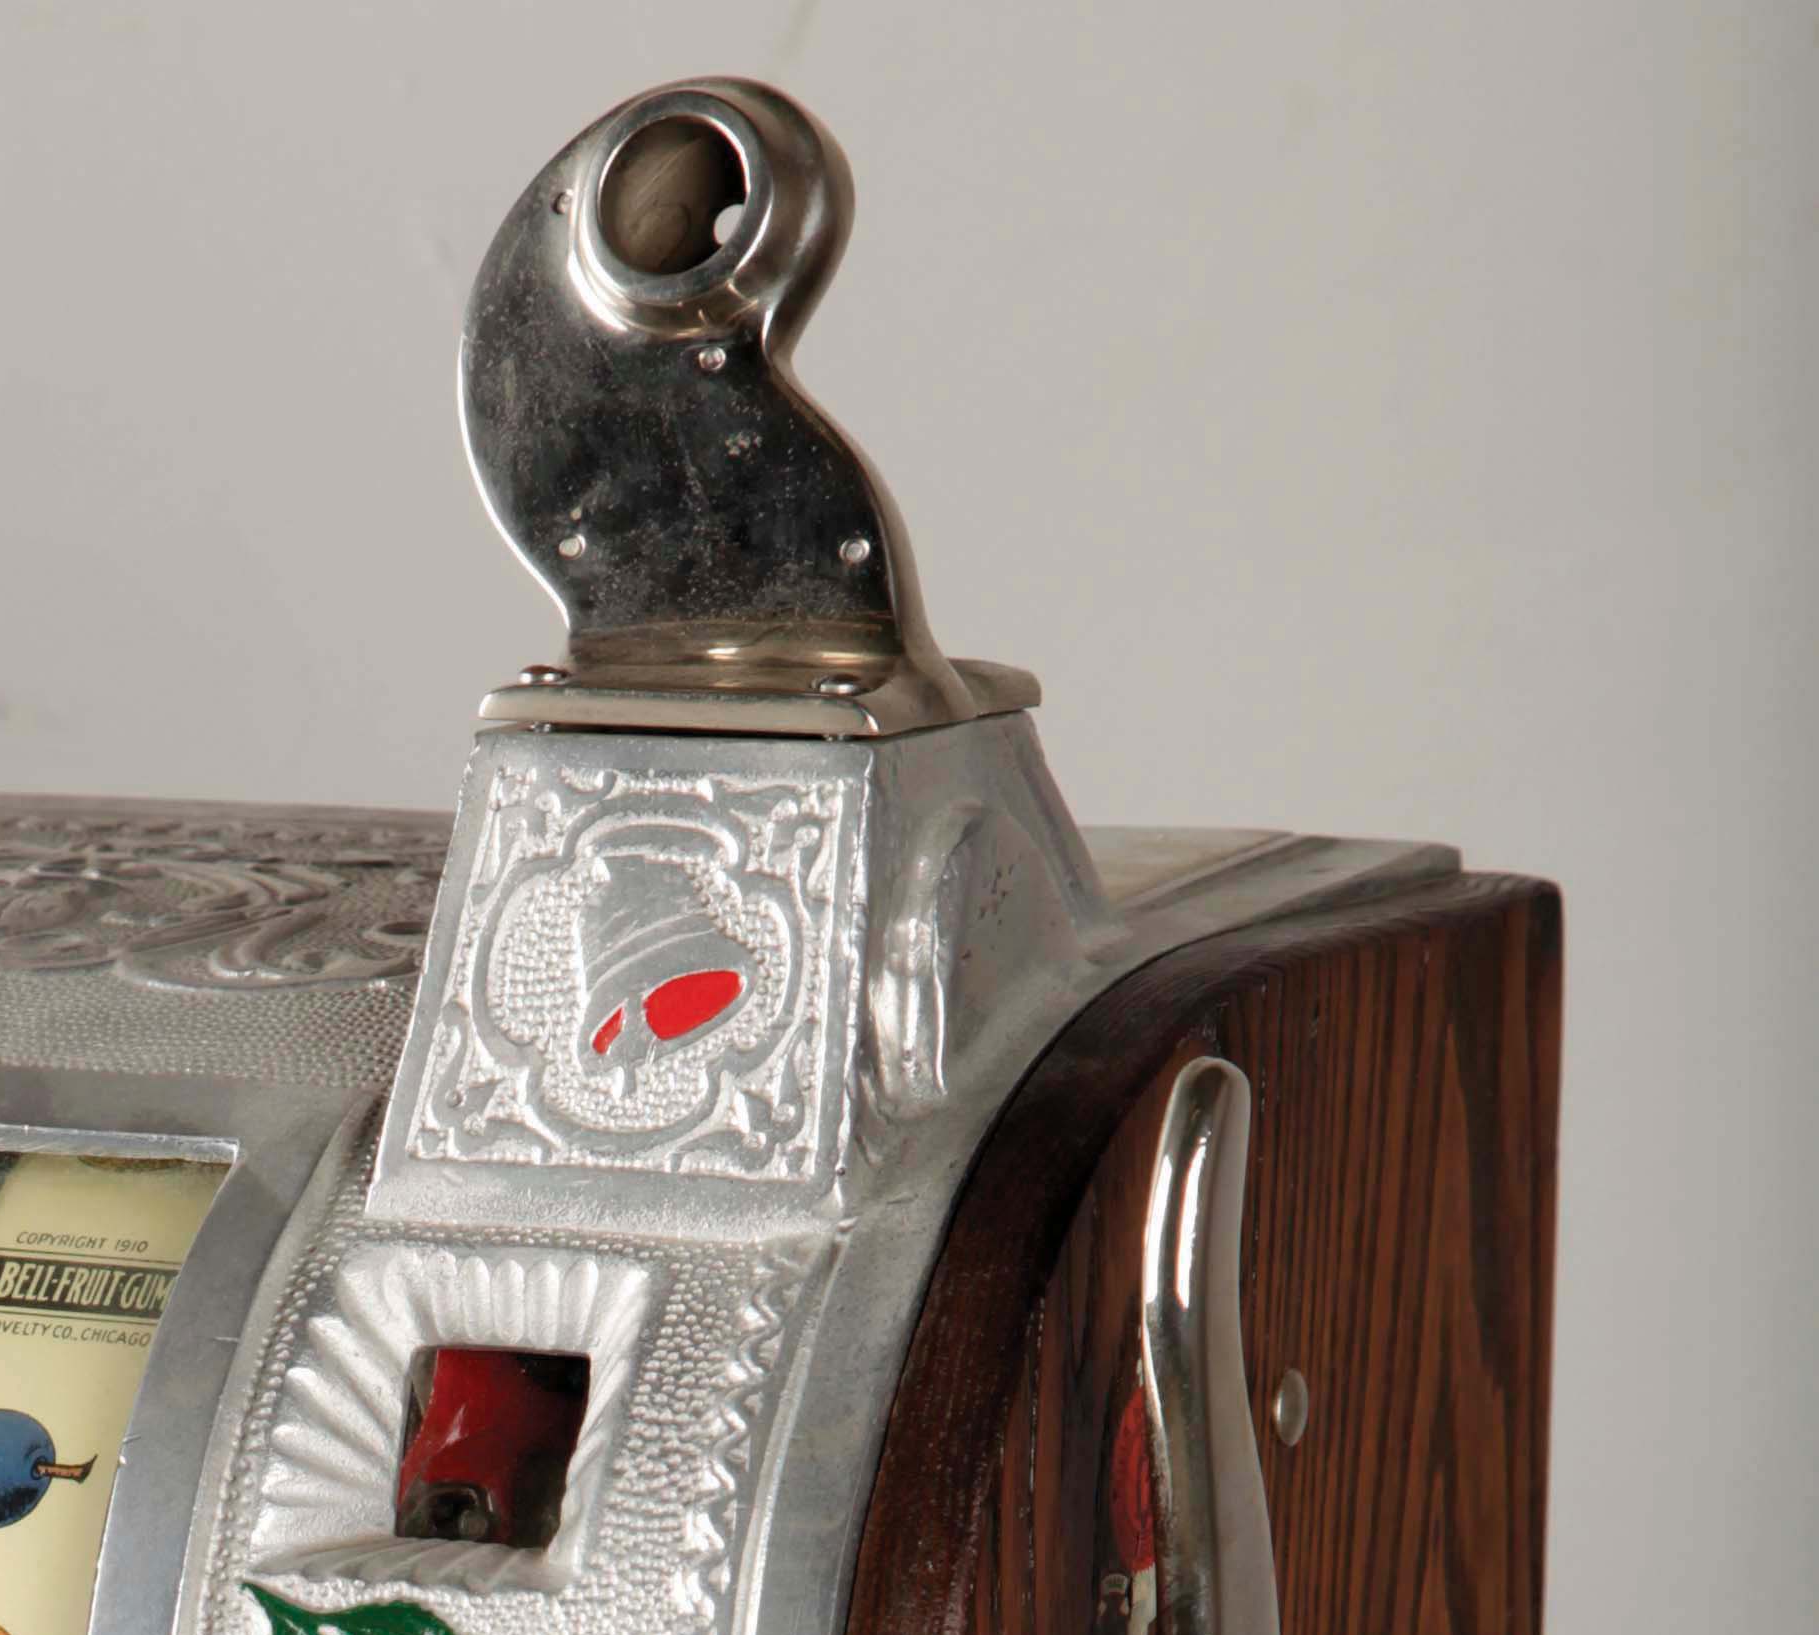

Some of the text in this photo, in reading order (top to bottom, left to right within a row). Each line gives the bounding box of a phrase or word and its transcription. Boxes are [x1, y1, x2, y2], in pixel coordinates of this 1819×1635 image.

[15, 1231, 149, 1254] COPYRIGHT 1910
[80, 1328, 151, 1348] CHICAGO
